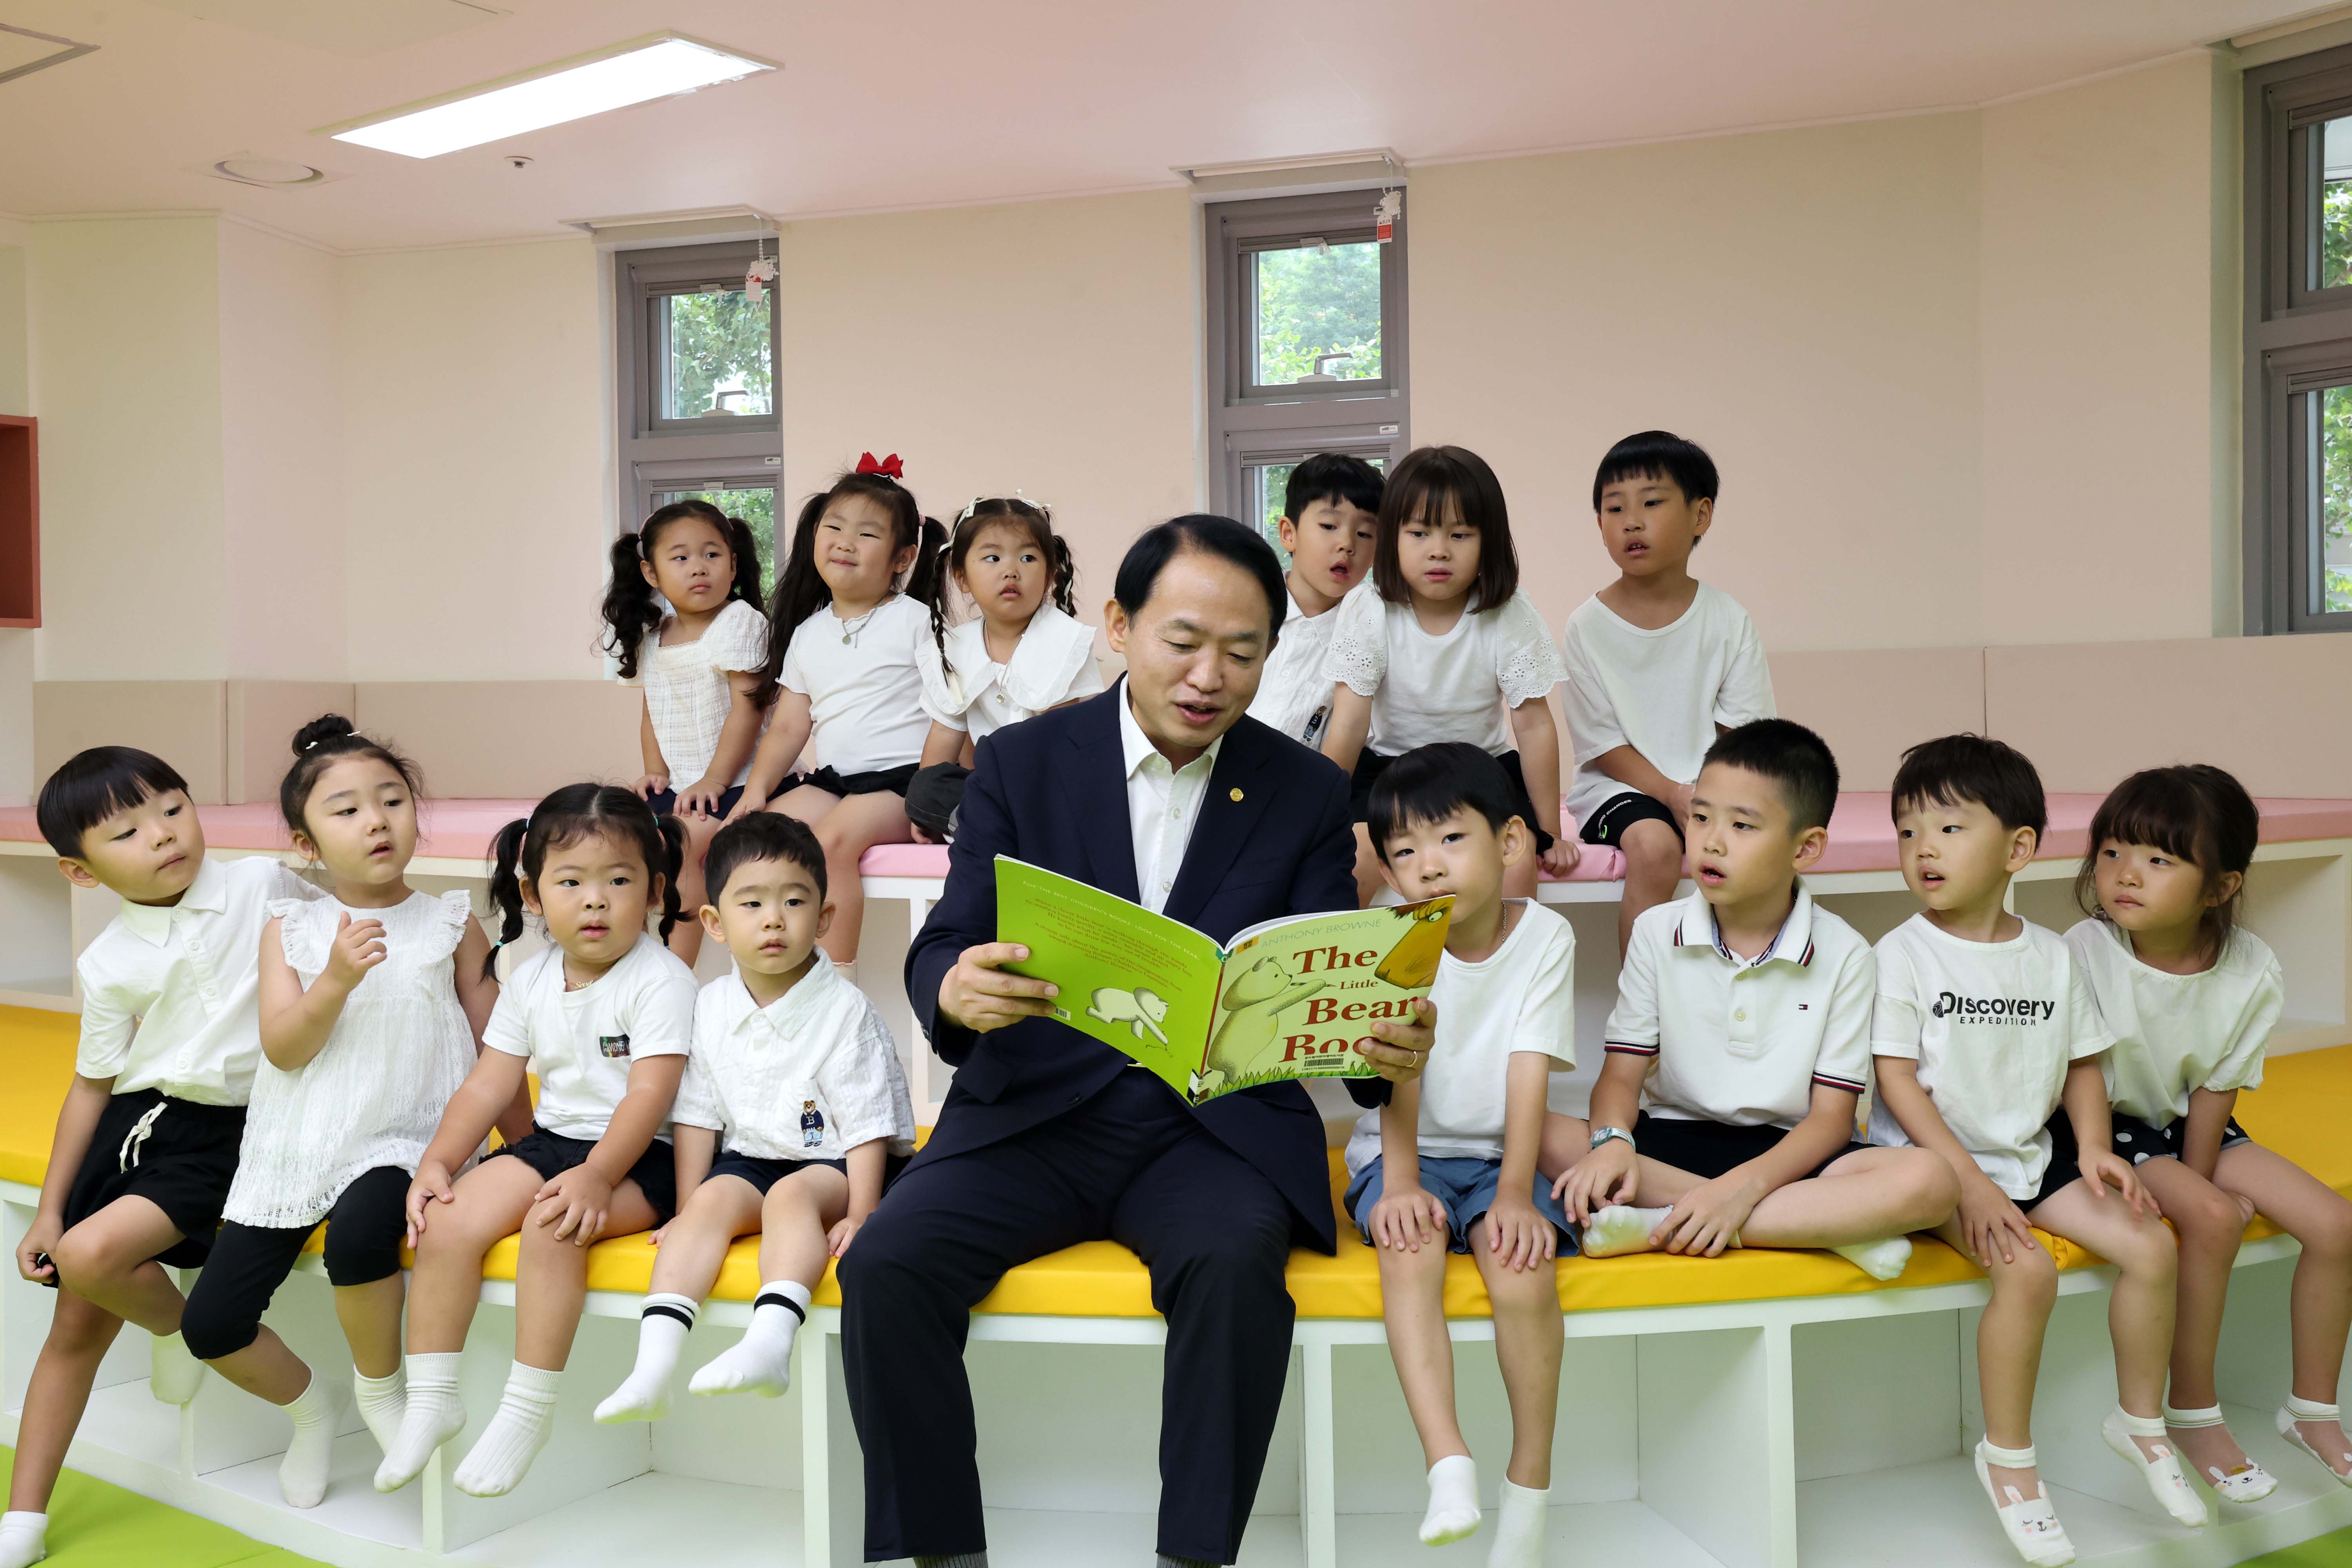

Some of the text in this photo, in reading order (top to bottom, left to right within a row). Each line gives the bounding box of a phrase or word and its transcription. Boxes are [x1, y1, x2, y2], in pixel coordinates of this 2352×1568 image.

[1606, 799, 1632, 815] CHANGES
[1261, 927, 1323, 948] ANTHONY
[1326, 919, 1381, 933] BROWNE
[1293, 946, 1377, 975] The
[1339, 979, 1378, 990] Little
[1302, 996, 1418, 1026] Bear
[1960, 1016, 2036, 1026] EXPEDITION
[806, 1116, 815, 1125] B
